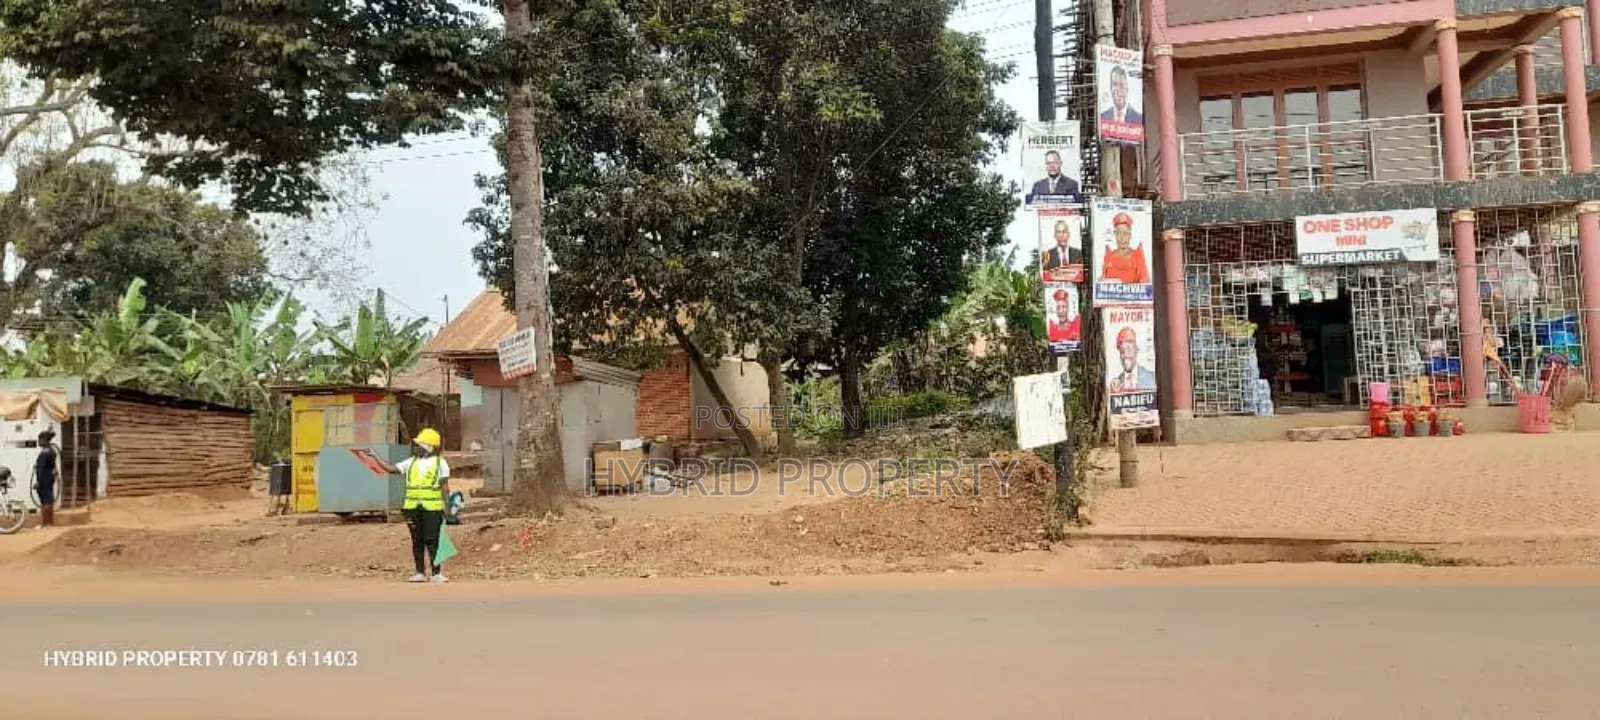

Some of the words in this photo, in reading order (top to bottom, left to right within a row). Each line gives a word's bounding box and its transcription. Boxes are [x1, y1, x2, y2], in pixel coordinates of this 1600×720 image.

[1028, 135, 1074, 145] HERBERT
[1303, 219, 1341, 234] ONE
[1343, 215, 1395, 231] SHOP
[1335, 235, 1368, 247] MINI
[1301, 250, 1399, 265] SUPERMARKET
